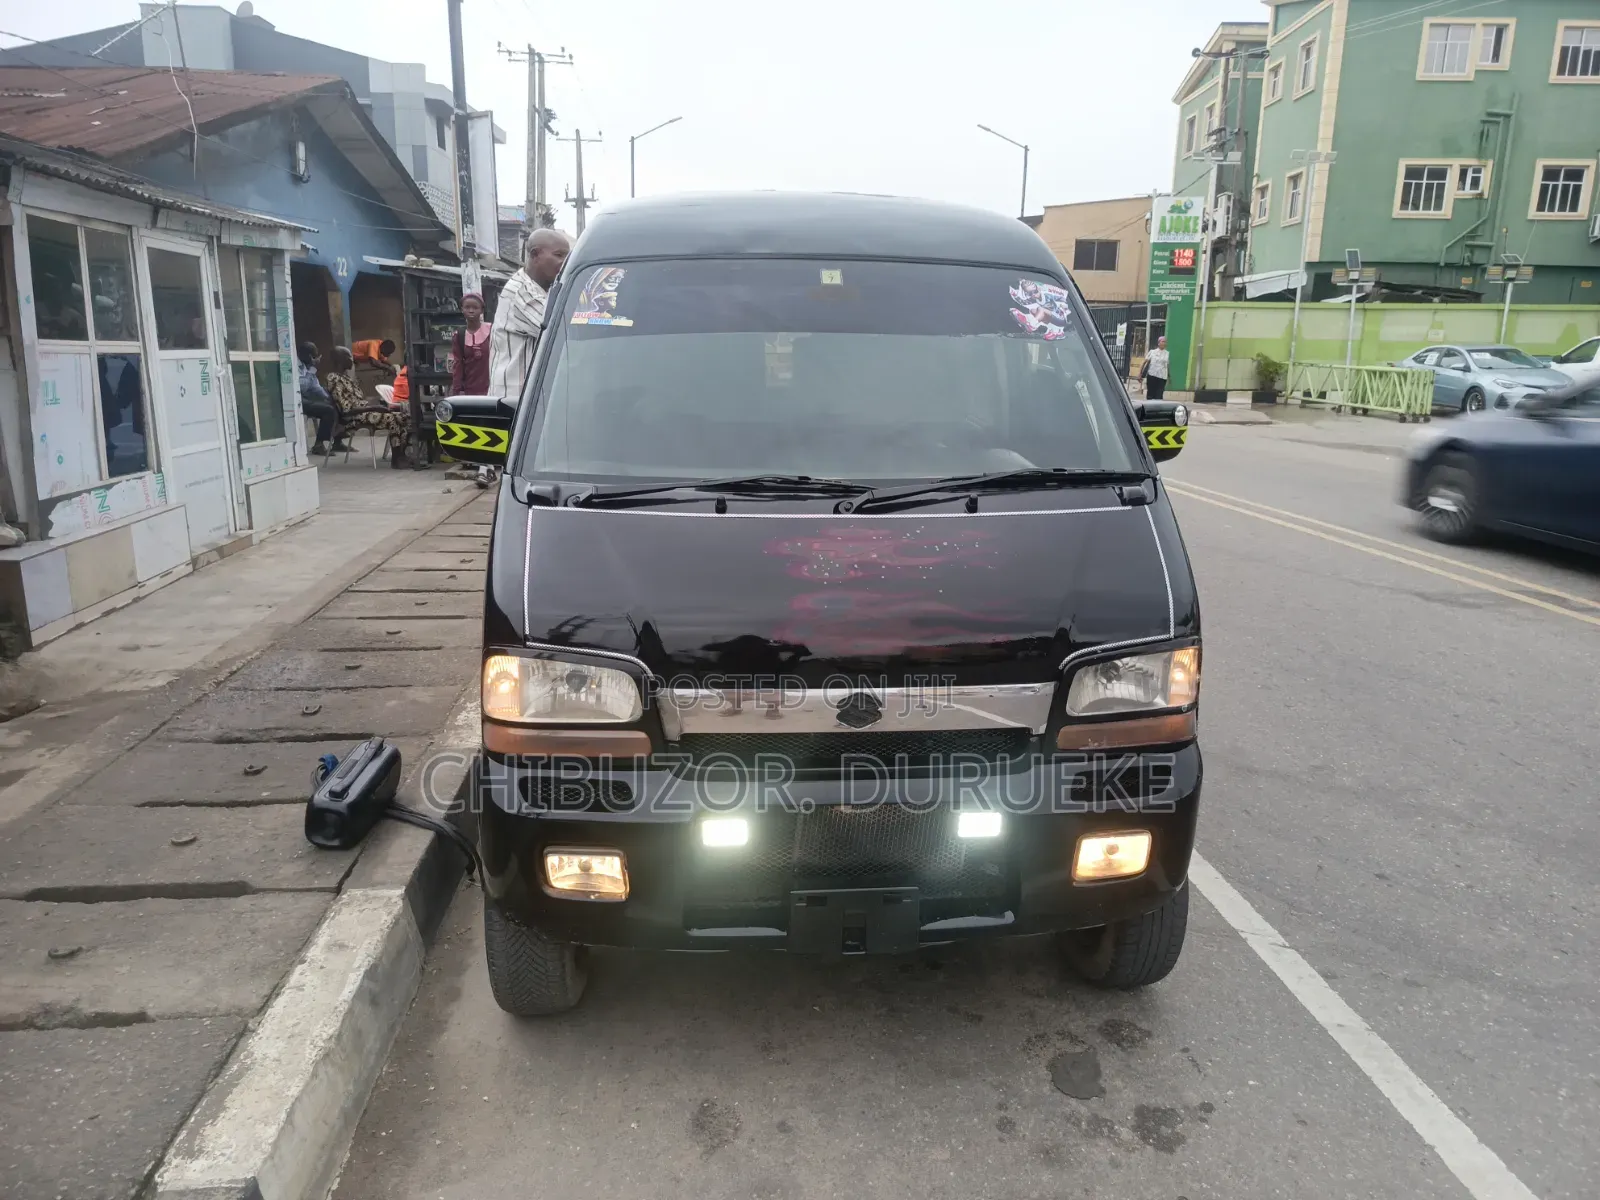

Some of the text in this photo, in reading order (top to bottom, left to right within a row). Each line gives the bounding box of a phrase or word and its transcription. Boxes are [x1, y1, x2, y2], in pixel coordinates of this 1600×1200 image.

[1158, 215, 1200, 234] AJOKE
[1174, 248, 1194, 258] 1140
[336, 256, 348, 277] 22
[1154, 287, 1190, 295] Supermarket
[1161, 294, 1182, 302] Bakery
